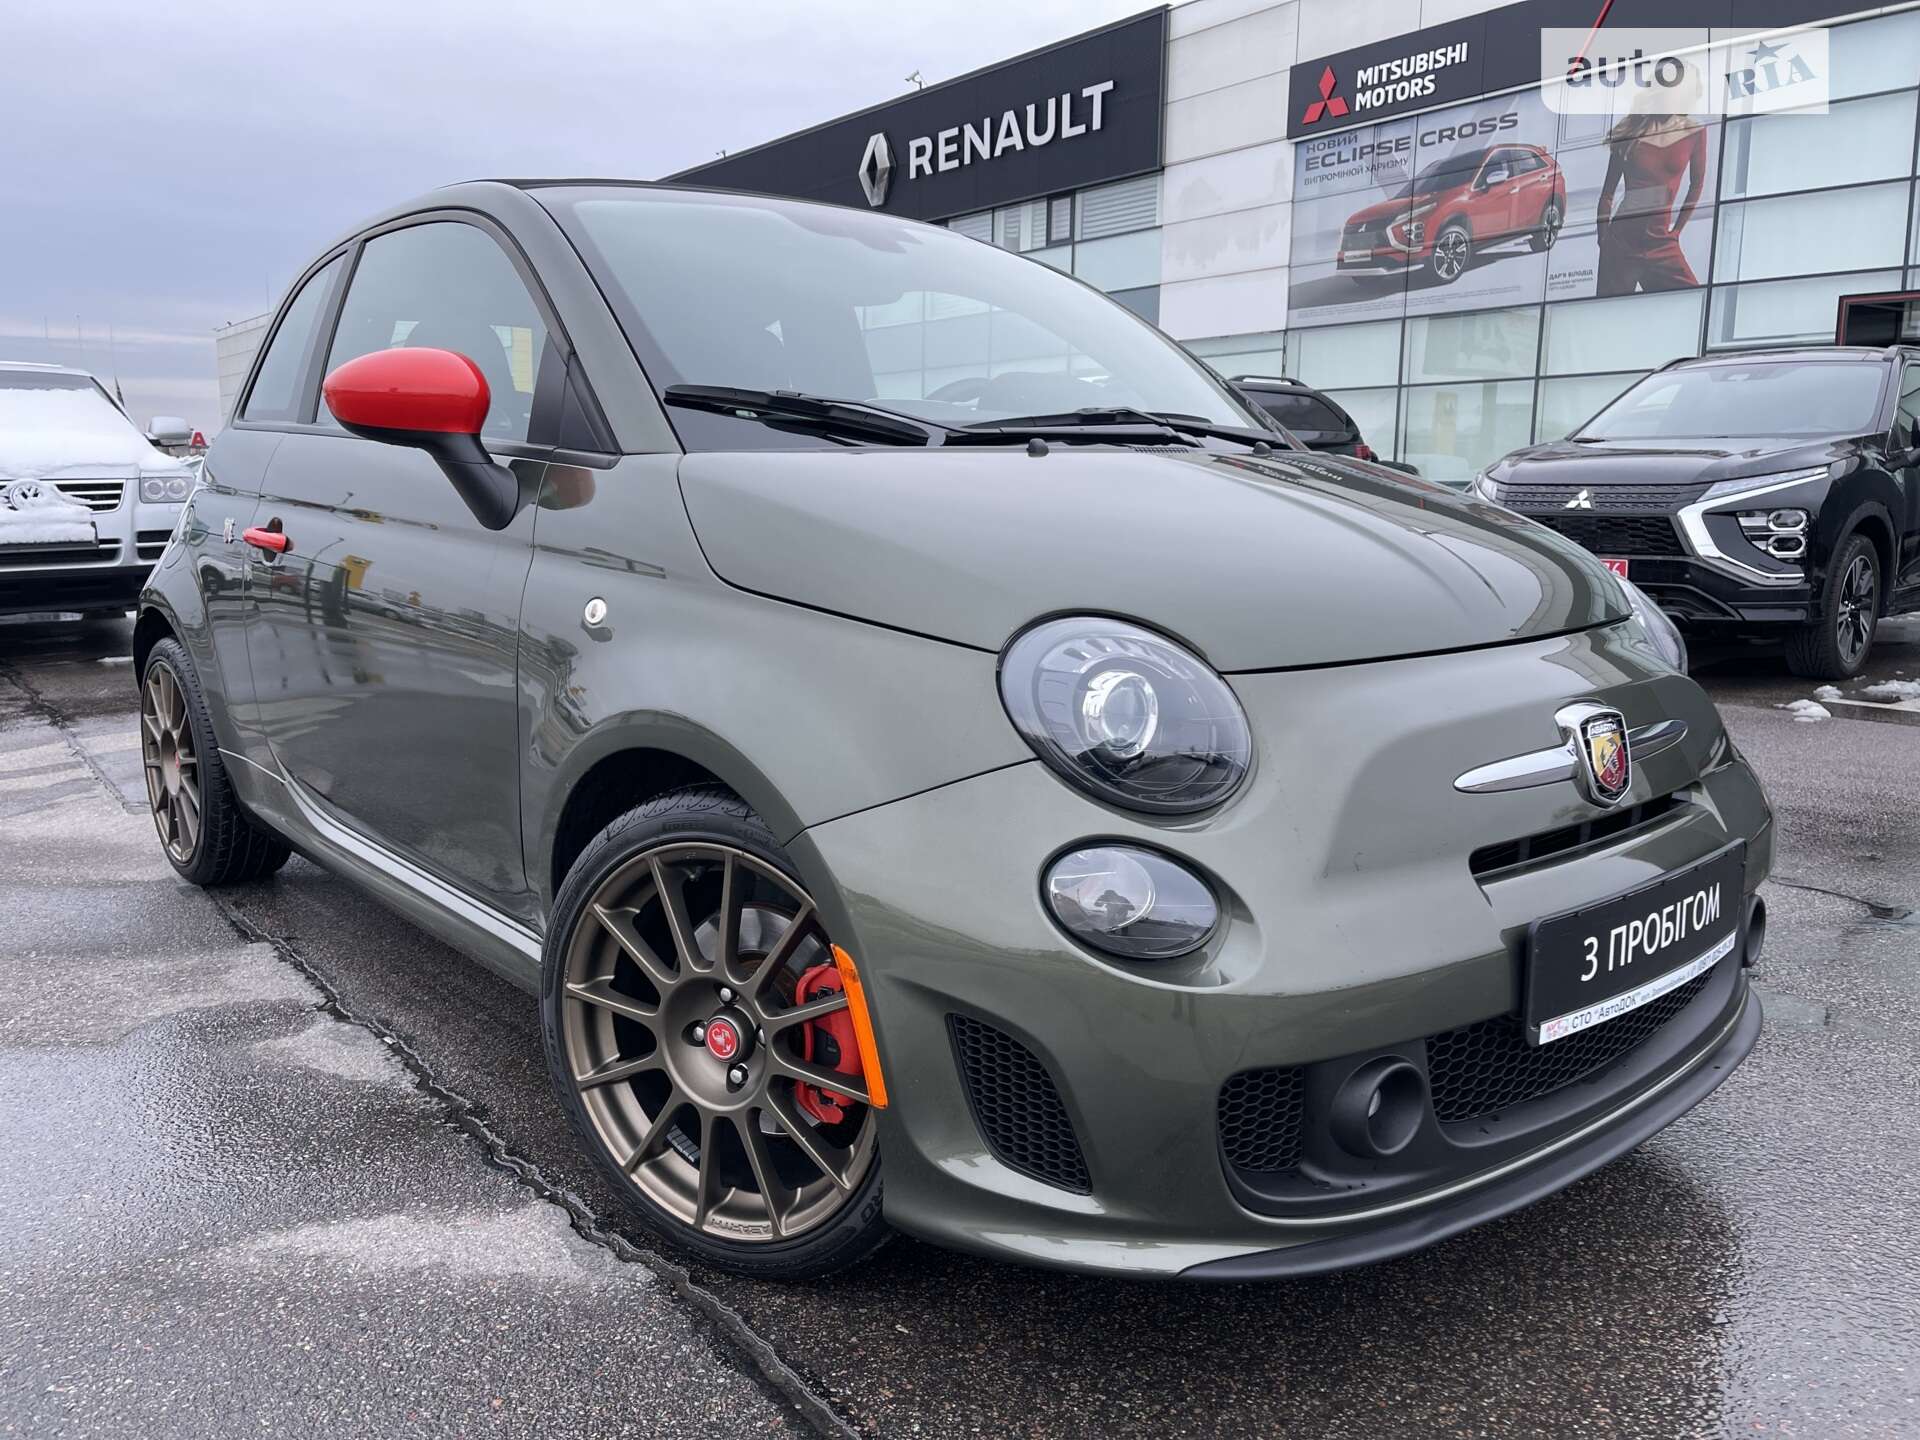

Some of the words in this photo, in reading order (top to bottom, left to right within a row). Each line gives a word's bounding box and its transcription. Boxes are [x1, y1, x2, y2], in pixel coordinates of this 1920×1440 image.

[1357, 42, 1468, 88] MITSUBISHI
[1355, 74, 1436, 111] MOTORS
[908, 79, 1115, 180] RENAULT
[1305, 135, 1411, 172] ECLIPSE
[1419, 112, 1518, 147] CROSS
[1306, 131, 1358, 154] НОВИЙ
[1304, 165, 1364, 186] ВИПРОМІНЮЙ
[1366, 156, 1409, 173] ХАРИЗМУ
[1608, 882, 1721, 971] ПРОБІГОМ
